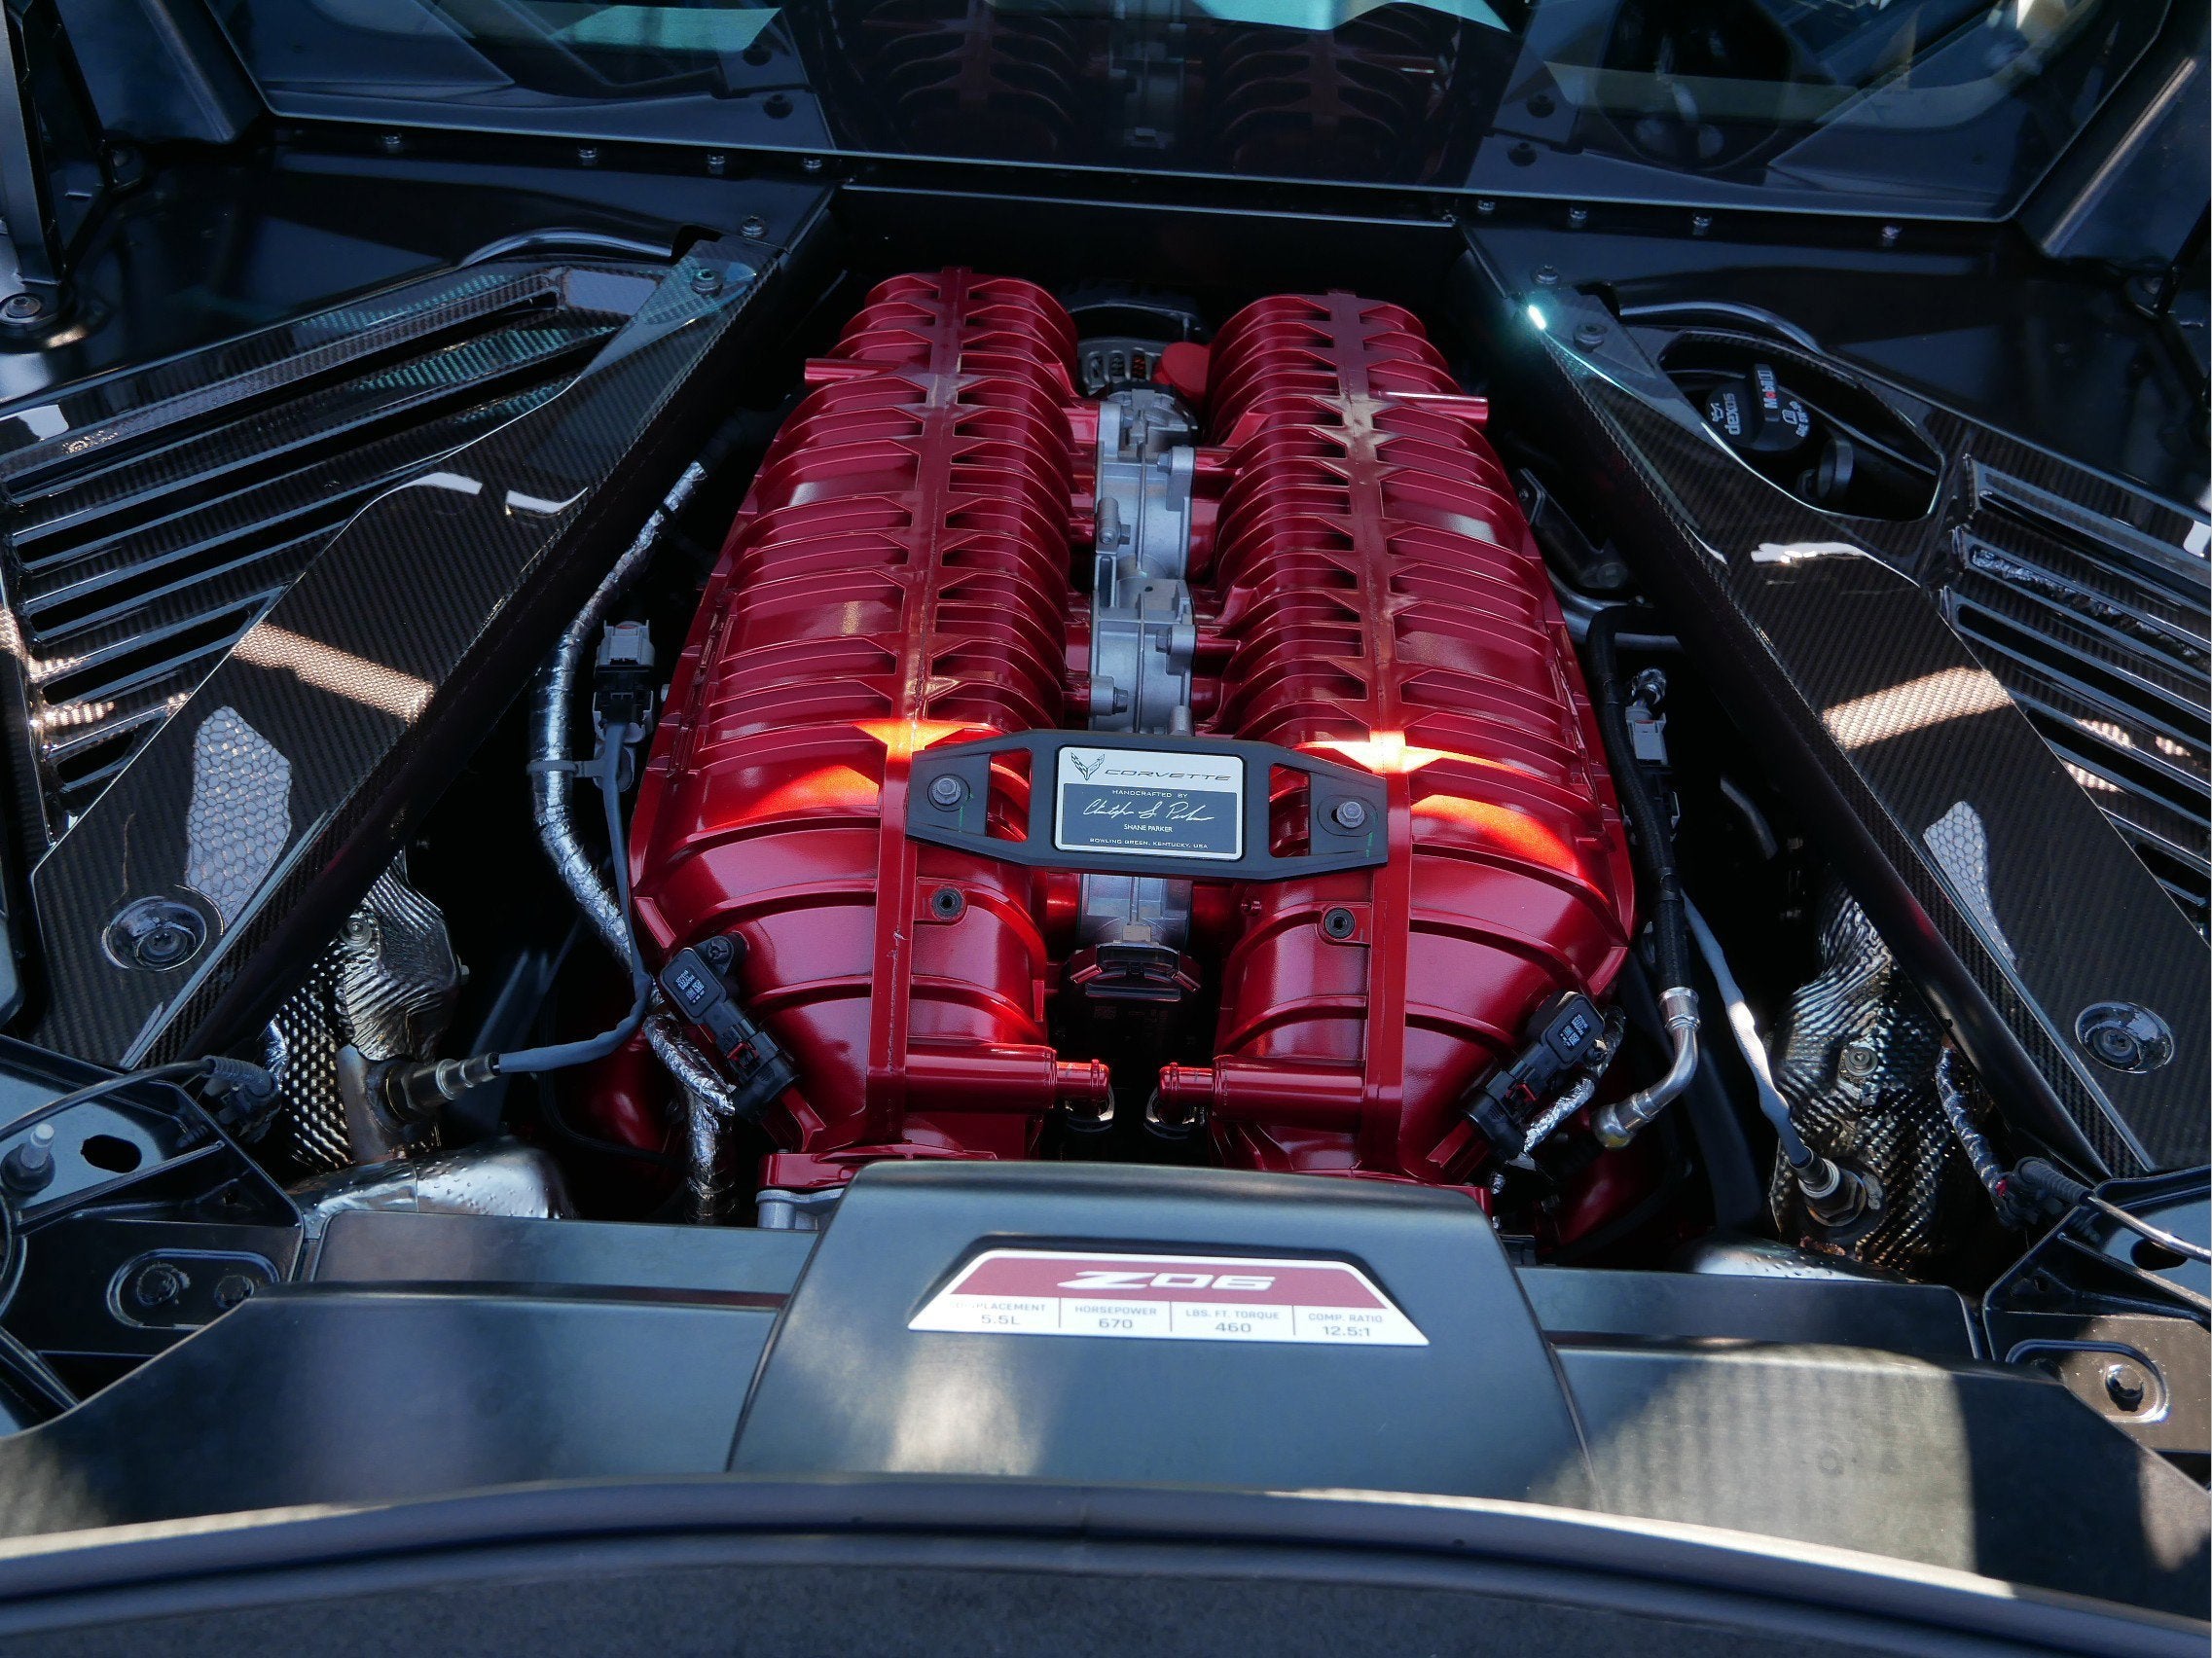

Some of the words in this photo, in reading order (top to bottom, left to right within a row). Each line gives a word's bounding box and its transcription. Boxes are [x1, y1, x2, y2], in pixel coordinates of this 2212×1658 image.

[1722, 392, 1741, 435] dexos
[1105, 769, 1231, 781] CORVETTE
[1111, 789, 1173, 798] HANDCRAFTED
[1056, 1270, 1277, 1291] Z06
[956, 1302, 1046, 1313] DPLACEMENT
[1074, 1305, 1157, 1316] HORSEPOWER
[980, 1314, 1021, 1325] 5.5L
[1185, 1309, 1211, 1318] LBS.
[1215, 1310, 1232, 1319] FT.
[1235, 1311, 1280, 1320] TORQUE
[1308, 1313, 1346, 1322] COMP.
[1349, 1314, 1383, 1324] RATIO
[1098, 1317, 1134, 1329] 670
[1215, 1321, 1252, 1333] 460
[1323, 1325, 1371, 1337] 12.5:1
